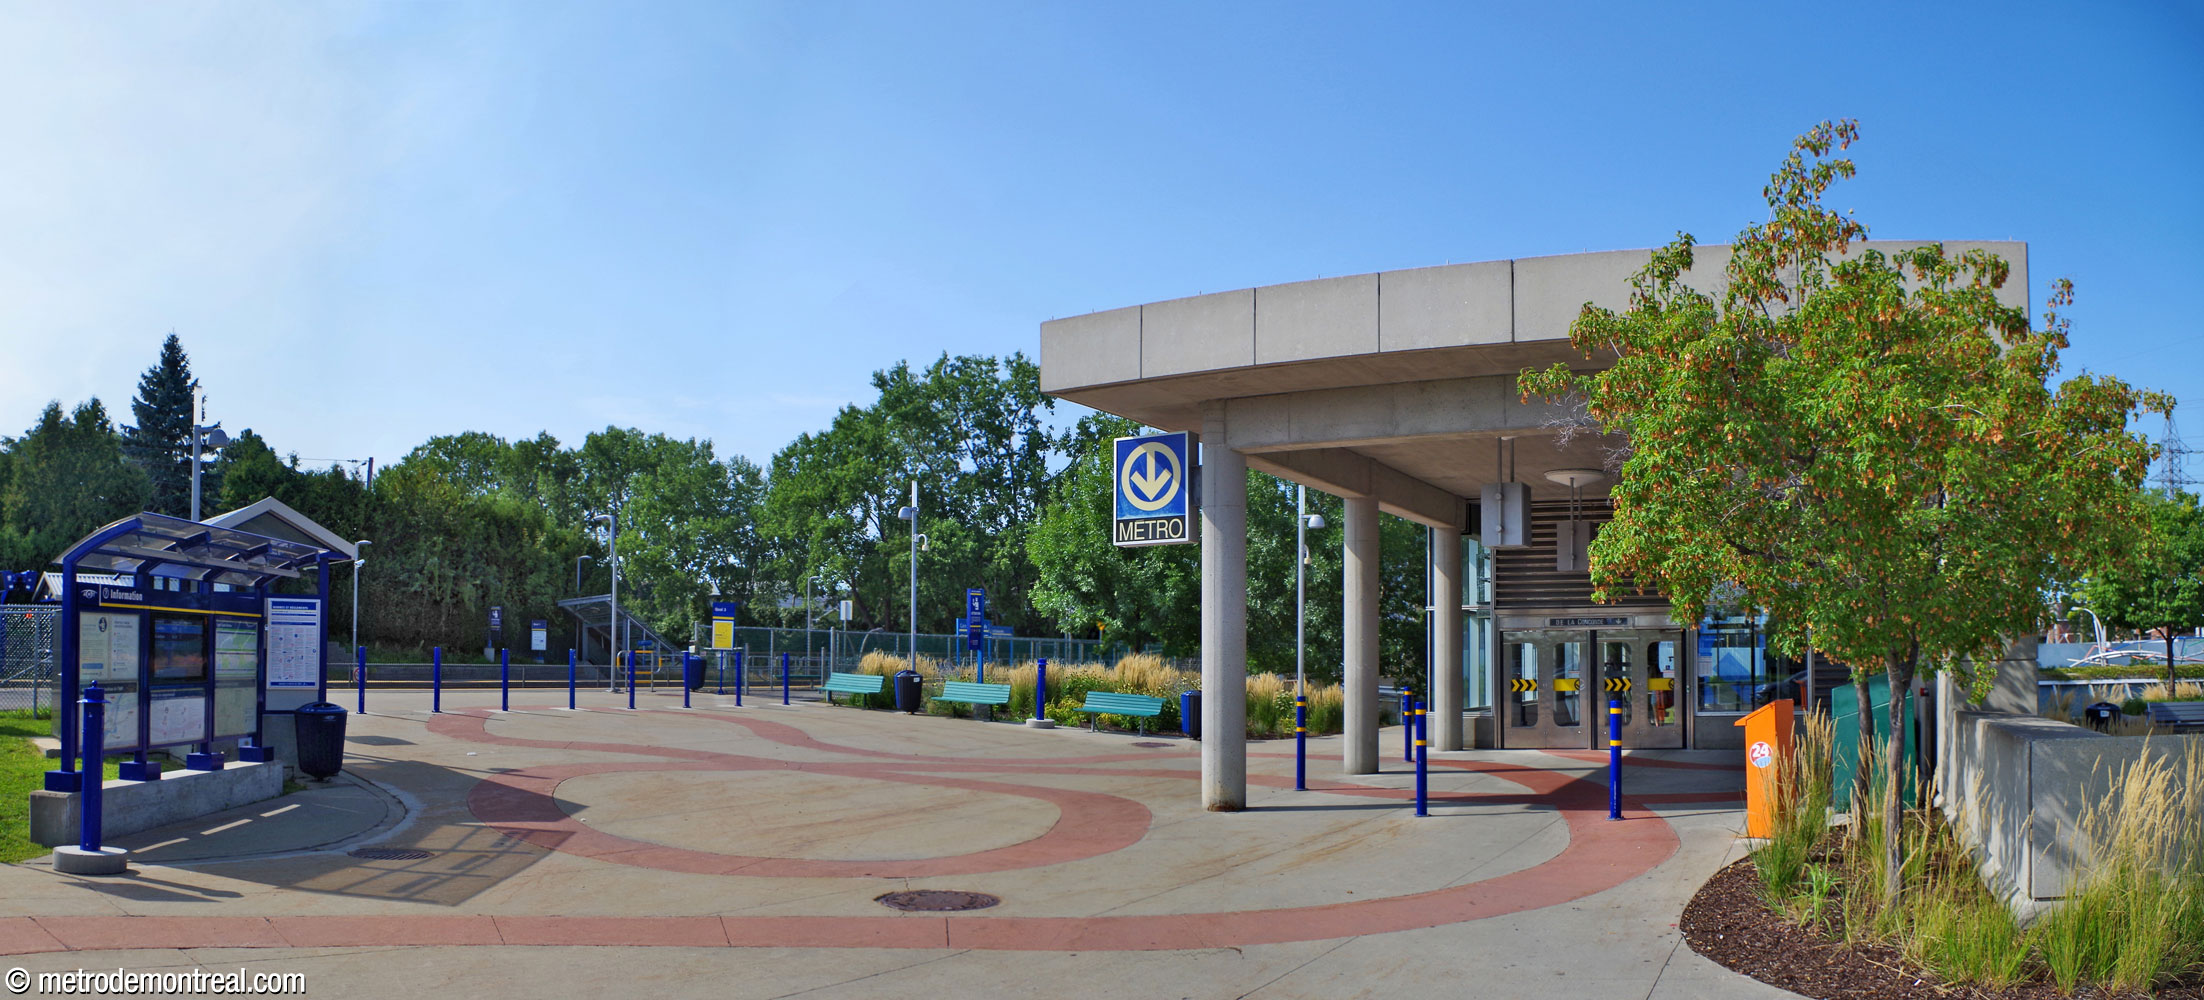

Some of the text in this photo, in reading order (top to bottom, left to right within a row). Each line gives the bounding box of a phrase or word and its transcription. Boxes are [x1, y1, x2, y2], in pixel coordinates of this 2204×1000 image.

[1119, 518, 1183, 541] METRO
[110, 589, 143, 601] Information
[1752, 744, 1769, 758] 24
